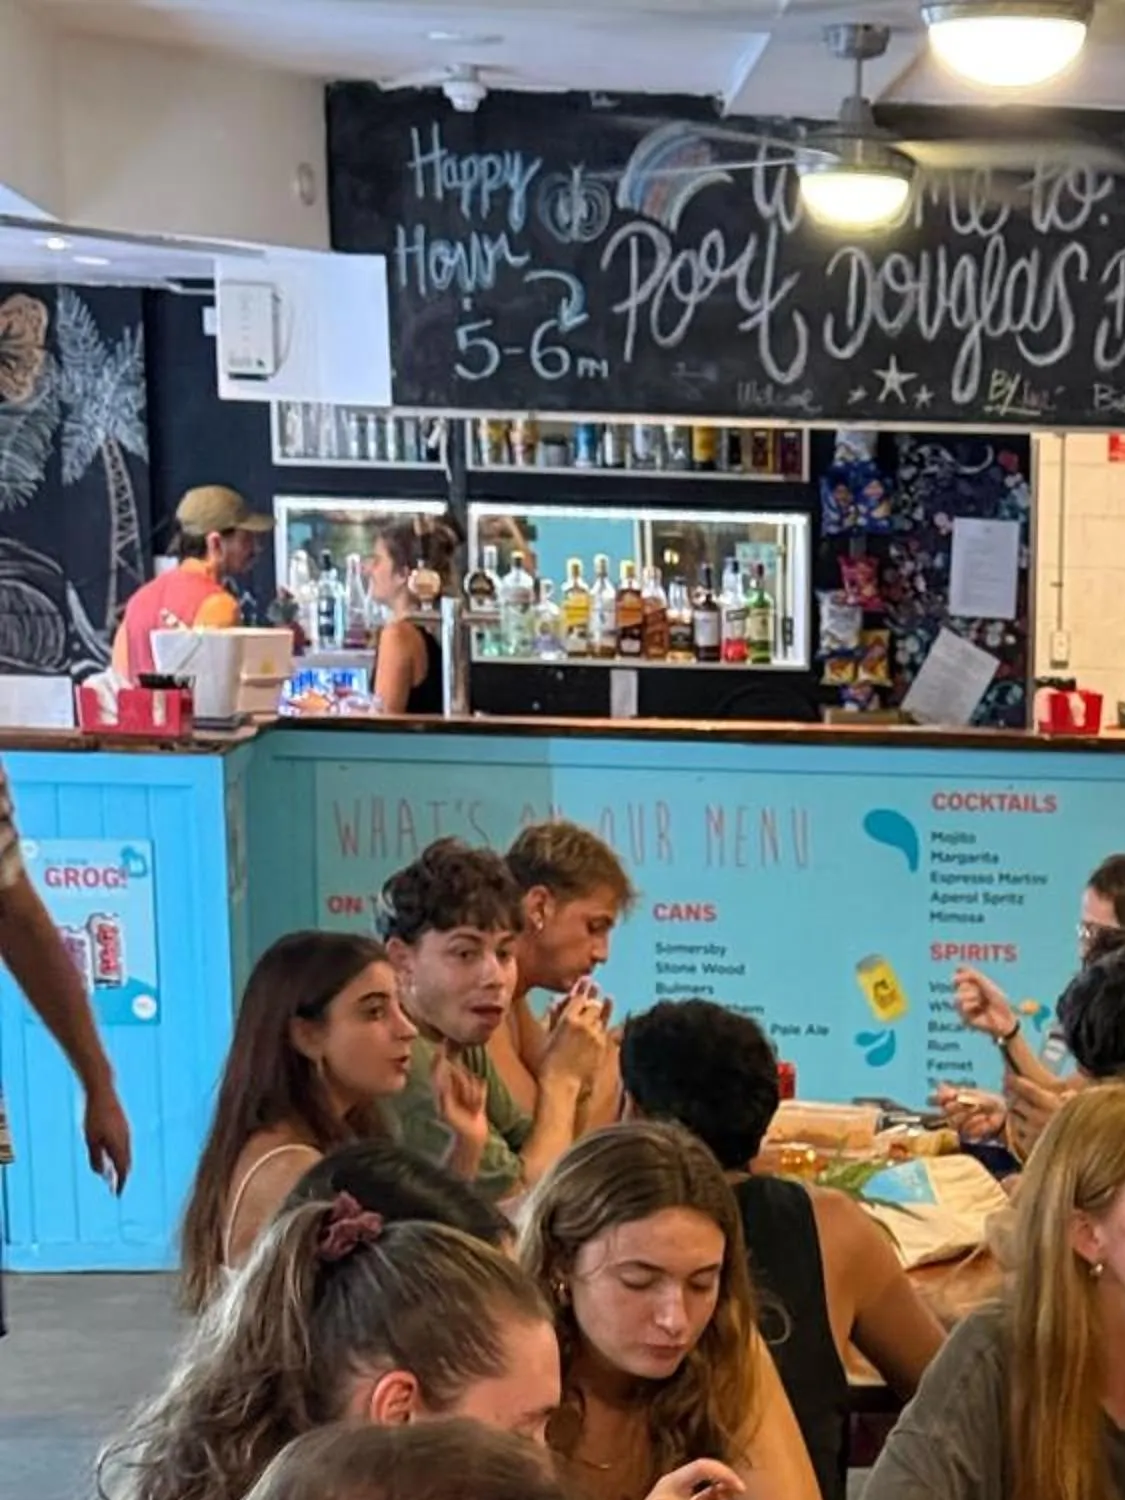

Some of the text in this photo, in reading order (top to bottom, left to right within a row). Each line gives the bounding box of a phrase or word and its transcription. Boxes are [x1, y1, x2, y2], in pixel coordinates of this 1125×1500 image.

[408, 121, 542, 232] Happy
[394, 224, 530, 296] Hour
[600, 220, 808, 386] Port
[824, 234, 1089, 403] Douglas
[931, 792, 1058, 813] COCKTAILS
[333, 796, 491, 858] WHAT'S
[705, 802, 809, 869] MENU
[931, 831, 977, 845] Mojito
[931, 851, 999, 865] Margarita
[45, 866, 128, 888] GROG!
[930, 871, 994, 885] Espresso
[327, 895, 363, 914] ON
[930, 891, 1025, 905] Aperol Spritz
[653, 903, 717, 922] CANS
[930, 911, 985, 924] Mimosa
[655, 942, 726, 957] Somersby
[930, 942, 1018, 962] SPIRITS
[655, 962, 746, 975] Stone Wood
[655, 982, 715, 995] Bulmers
[770, 1023, 830, 1037] Pale Ale
[927, 1040, 961, 1051] Rum
[926, 1058, 974, 1071] Fernet
